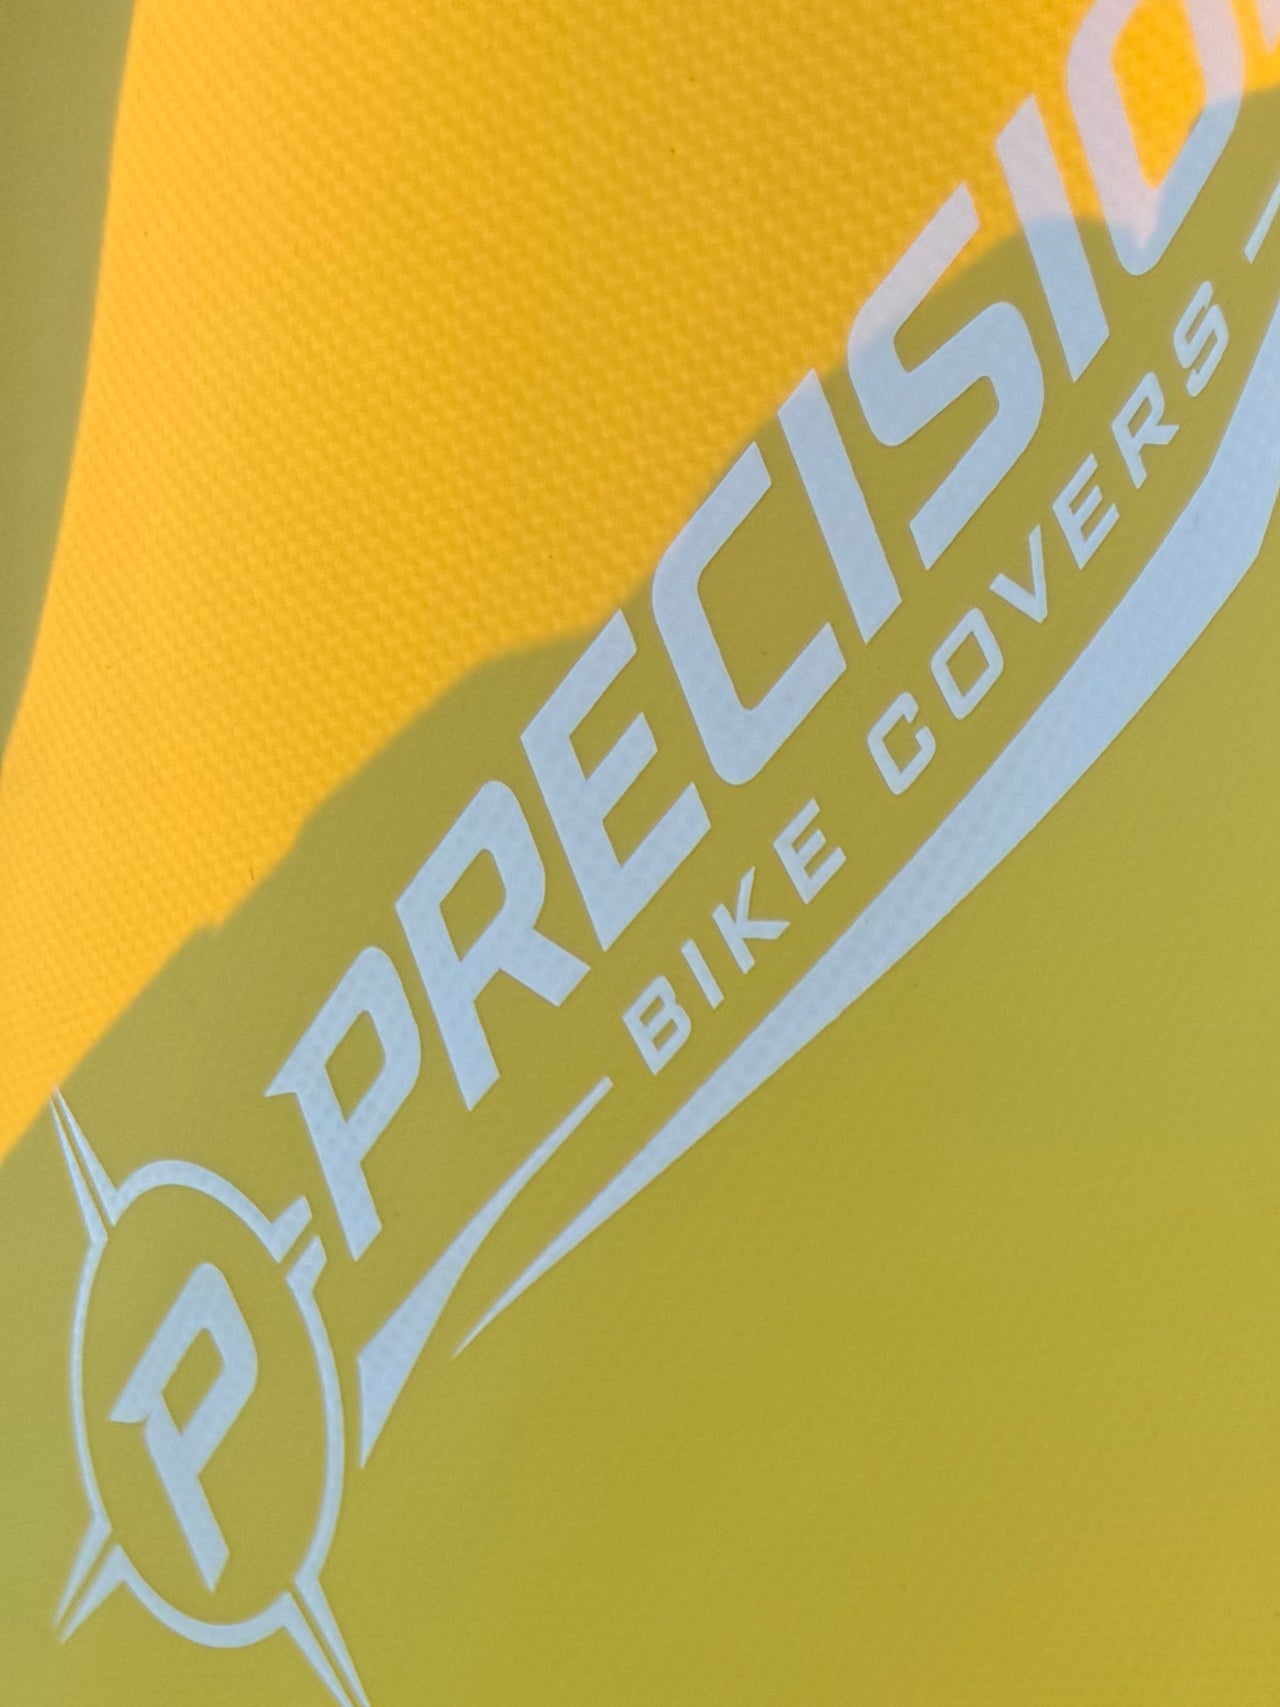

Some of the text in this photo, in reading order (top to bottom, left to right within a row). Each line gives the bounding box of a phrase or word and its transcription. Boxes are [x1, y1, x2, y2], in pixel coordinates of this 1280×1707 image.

[622, 280, 1230, 1075] BIKE COVERS
[110, 1261, 260, 1592] P
